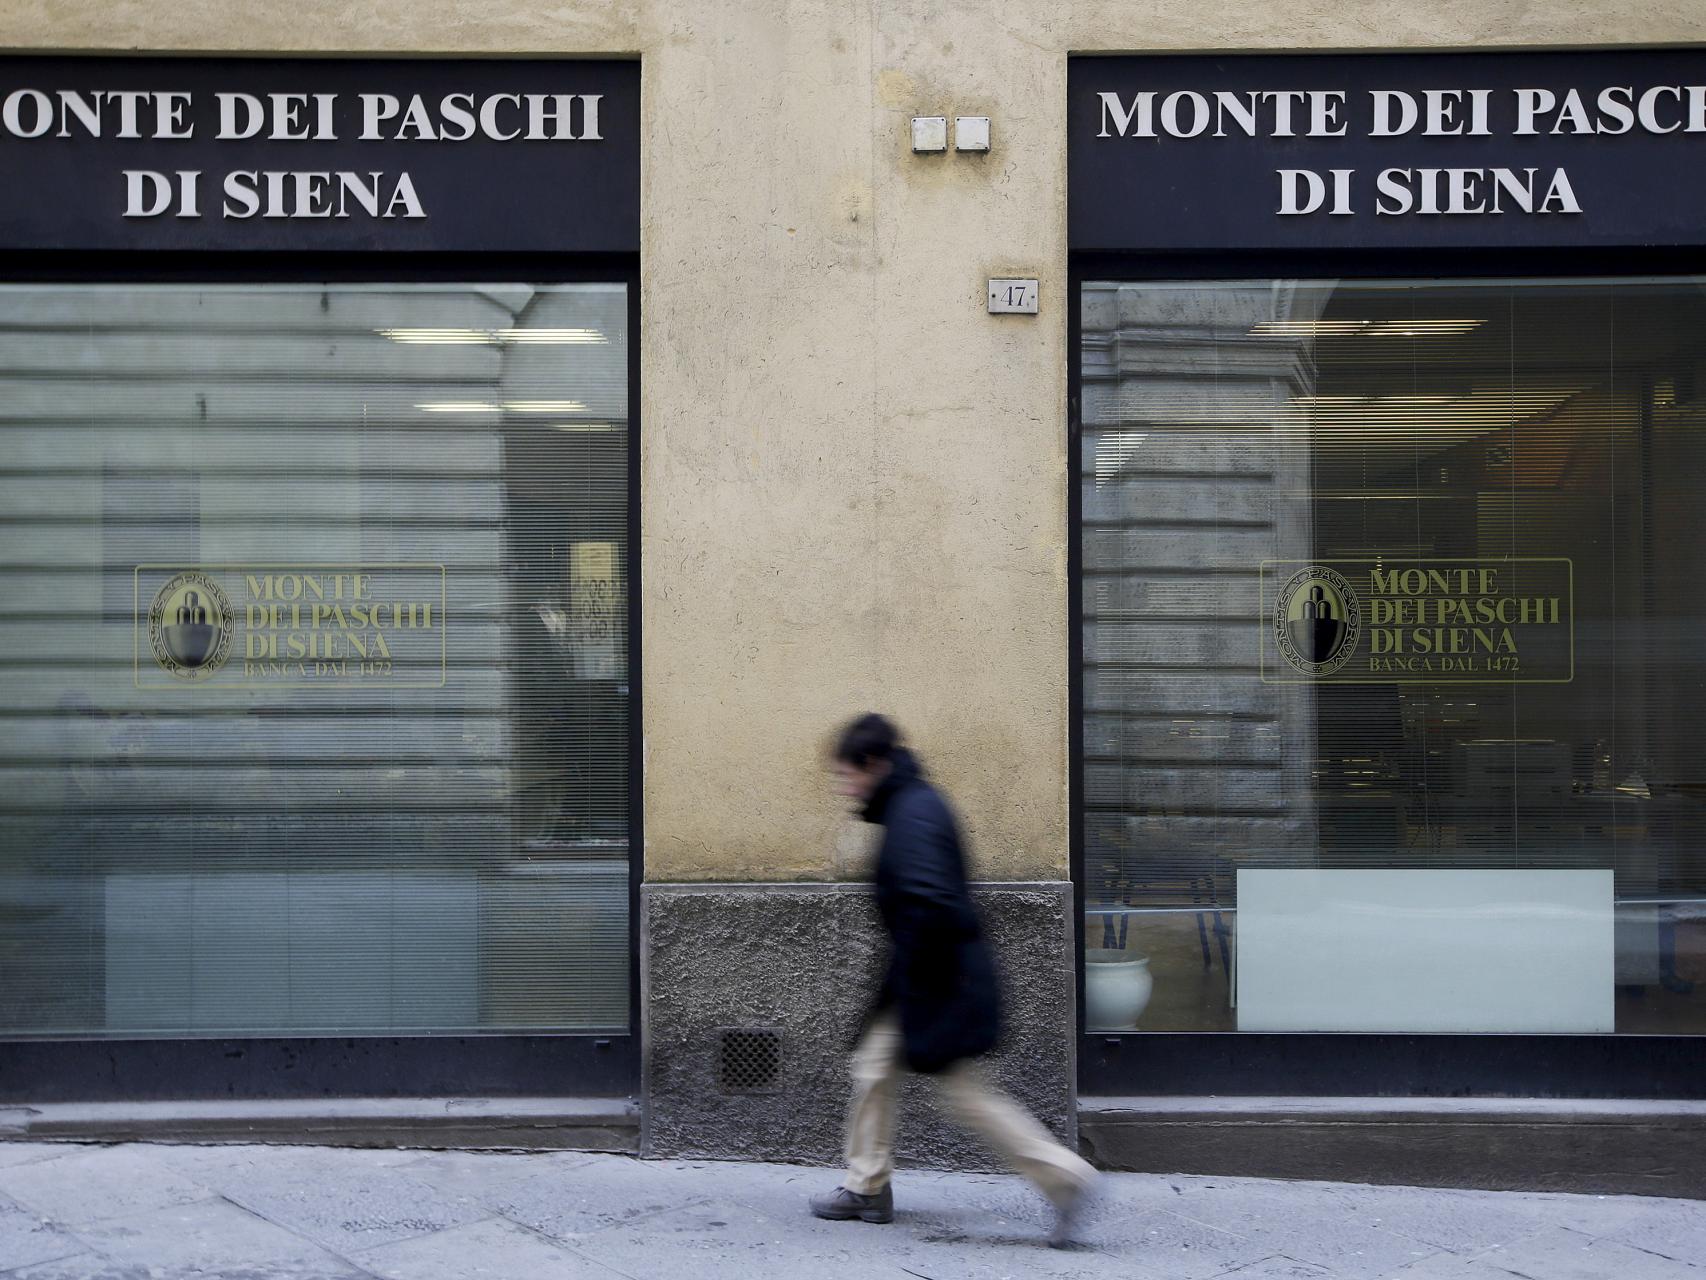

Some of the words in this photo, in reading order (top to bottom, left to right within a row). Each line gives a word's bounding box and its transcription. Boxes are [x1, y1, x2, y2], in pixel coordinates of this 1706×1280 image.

[215, 93, 338, 139] DEI
[358, 93, 603, 140] PASCHI
[1097, 91, 1347, 137] MONTE
[1368, 90, 1493, 135] DEI
[122, 171, 201, 217] DI
[224, 171, 426, 218] SIENA
[1276, 170, 1355, 215] DI
[1377, 168, 1583, 215] SIENA
[1000, 286, 1026, 306] 47
[245, 574, 373, 600] MONTE
[1368, 569, 1499, 595] MONTE
[245, 603, 300, 629] DEI
[311, 603, 432, 629] PASCHI
[1369, 598, 1426, 624] DEI
[1436, 598, 1560, 624] PASCHI
[245, 633, 277, 659] DI
[286, 632, 391, 659] SIENA
[1369, 628, 1403, 653] DI
[1412, 627, 1518, 654] SIENA
[244, 661, 306, 677] BANCA
[315, 661, 352, 677] DAL
[360, 661, 392, 677] 1472
[1369, 656, 1432, 672] BANCA
[1440, 656, 1479, 671] DAL
[1487, 656, 1520, 671] 1472
